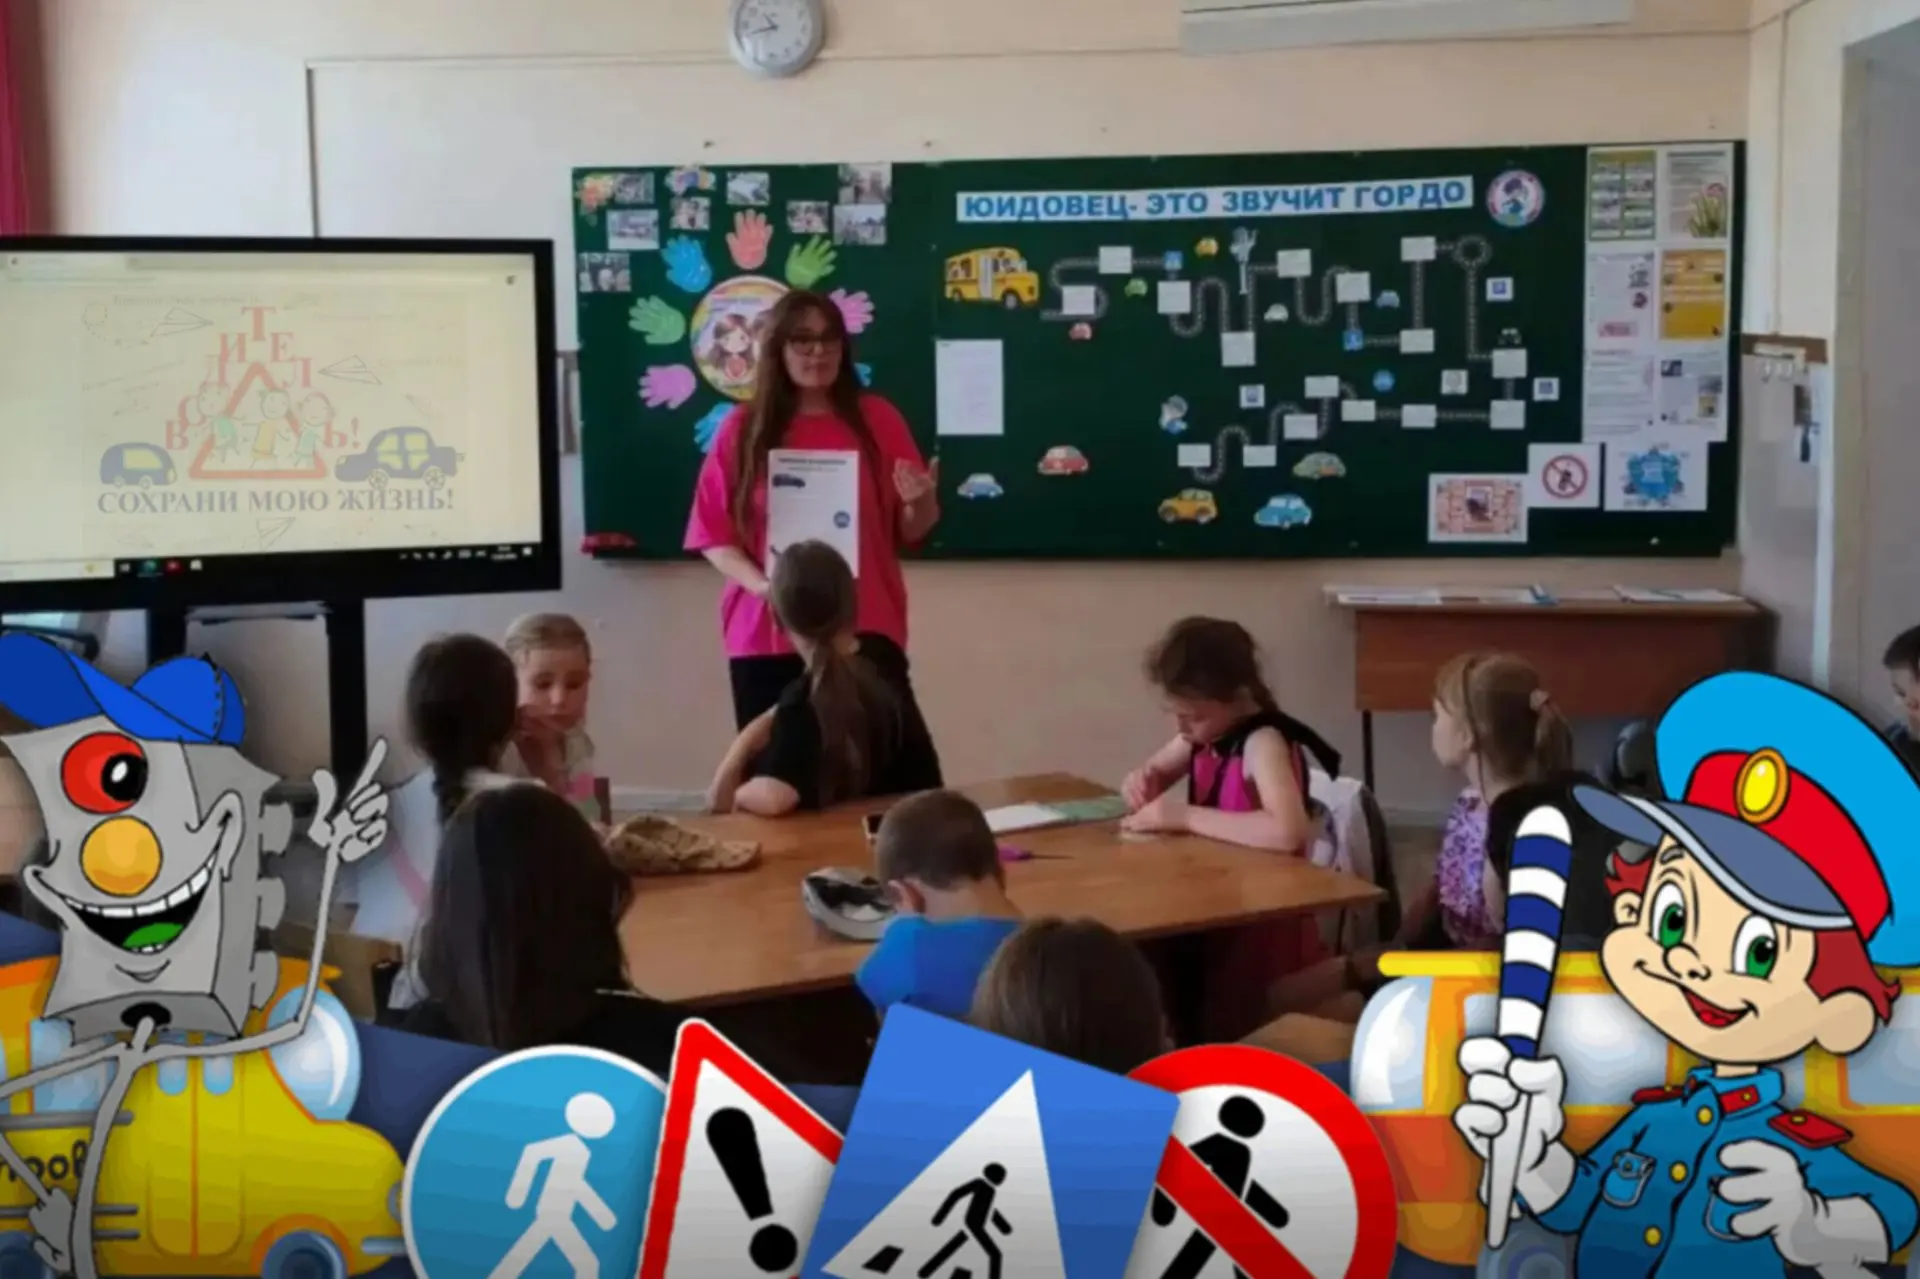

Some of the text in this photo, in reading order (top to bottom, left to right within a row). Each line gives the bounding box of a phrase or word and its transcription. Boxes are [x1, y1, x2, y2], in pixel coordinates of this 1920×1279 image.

[964, 180, 1466, 221] ЮИДОВЕЦ- ЭТО ЗВУЧИТ ГОРДО
[97, 487, 455, 514] СОХРАНИ МОЮ ЖИЗНЬ!
